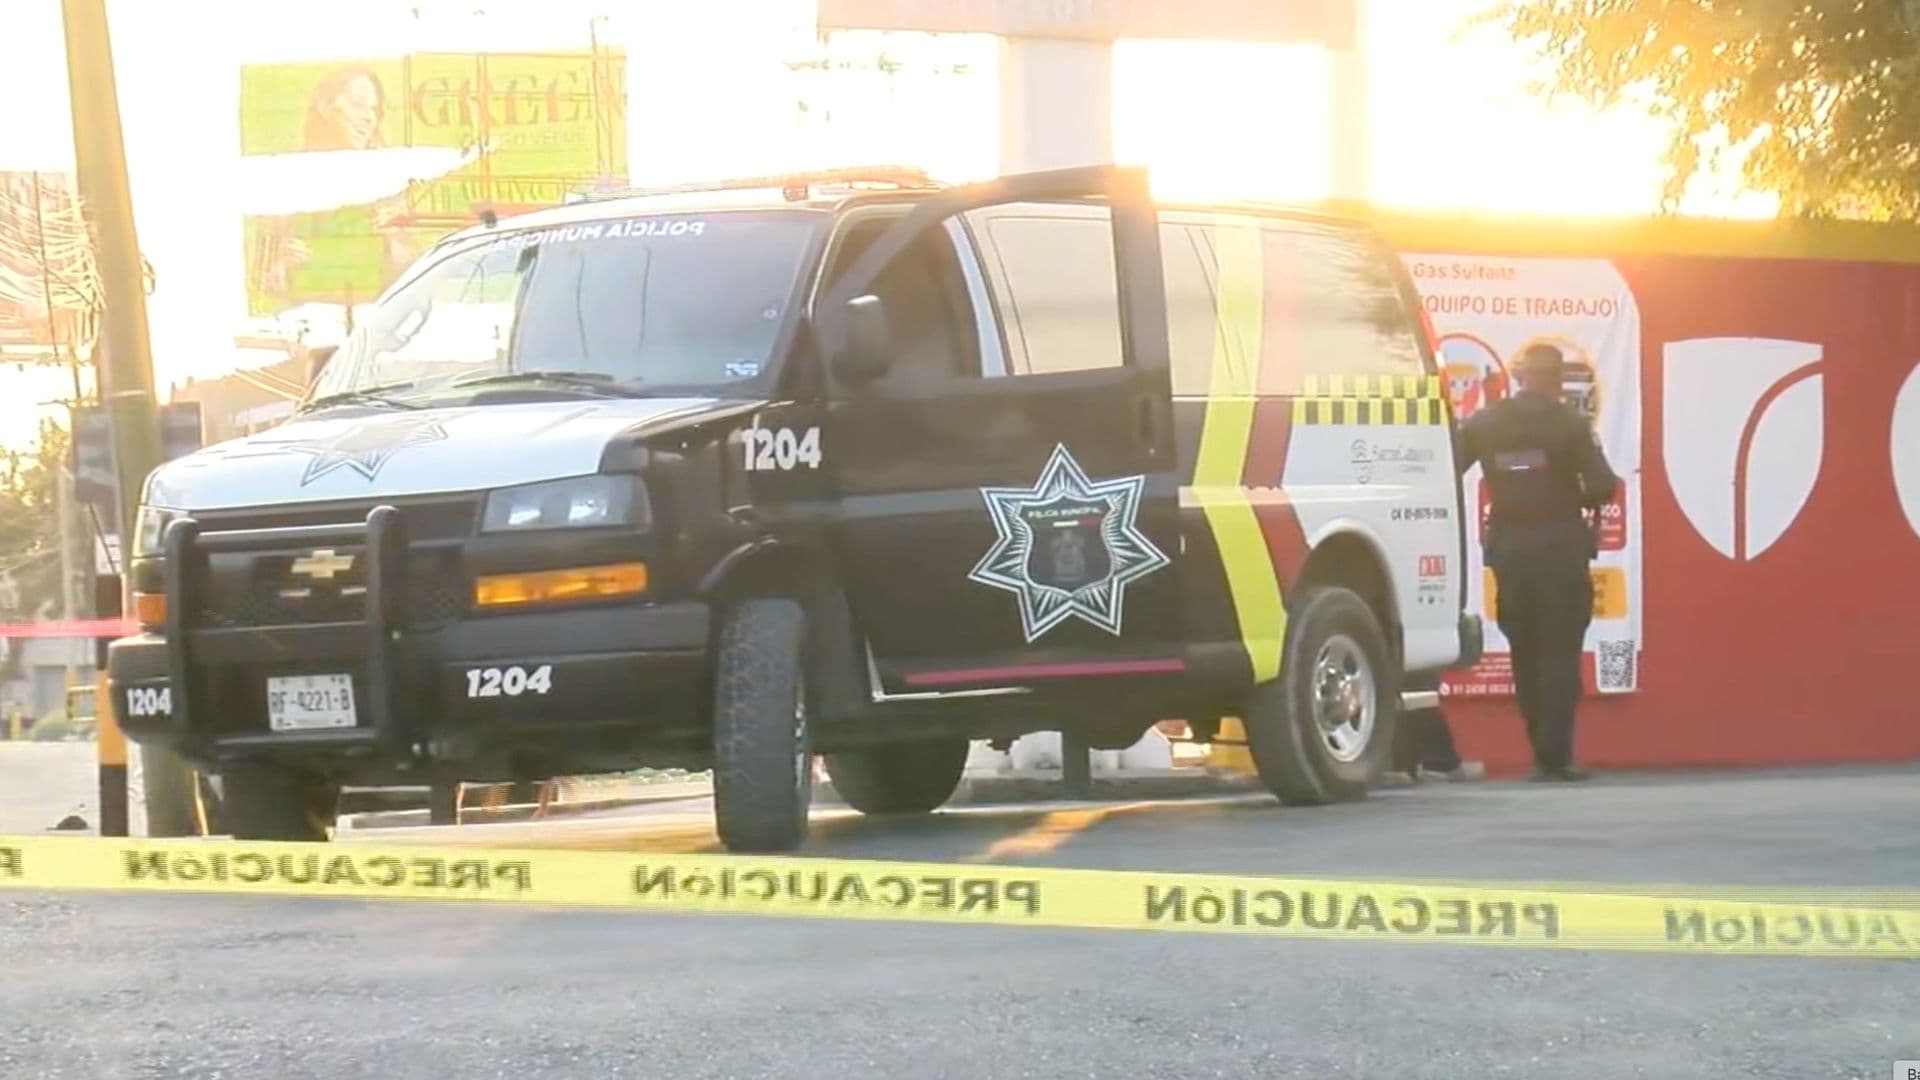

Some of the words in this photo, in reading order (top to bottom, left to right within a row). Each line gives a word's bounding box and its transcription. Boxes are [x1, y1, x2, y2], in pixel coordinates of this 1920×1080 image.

[1413, 263, 1446, 279] Gas
[1492, 297, 1517, 315] DE
[742, 427, 822, 471] 1204
[466, 664, 552, 698] 1204
[126, 687, 172, 717] 1204
